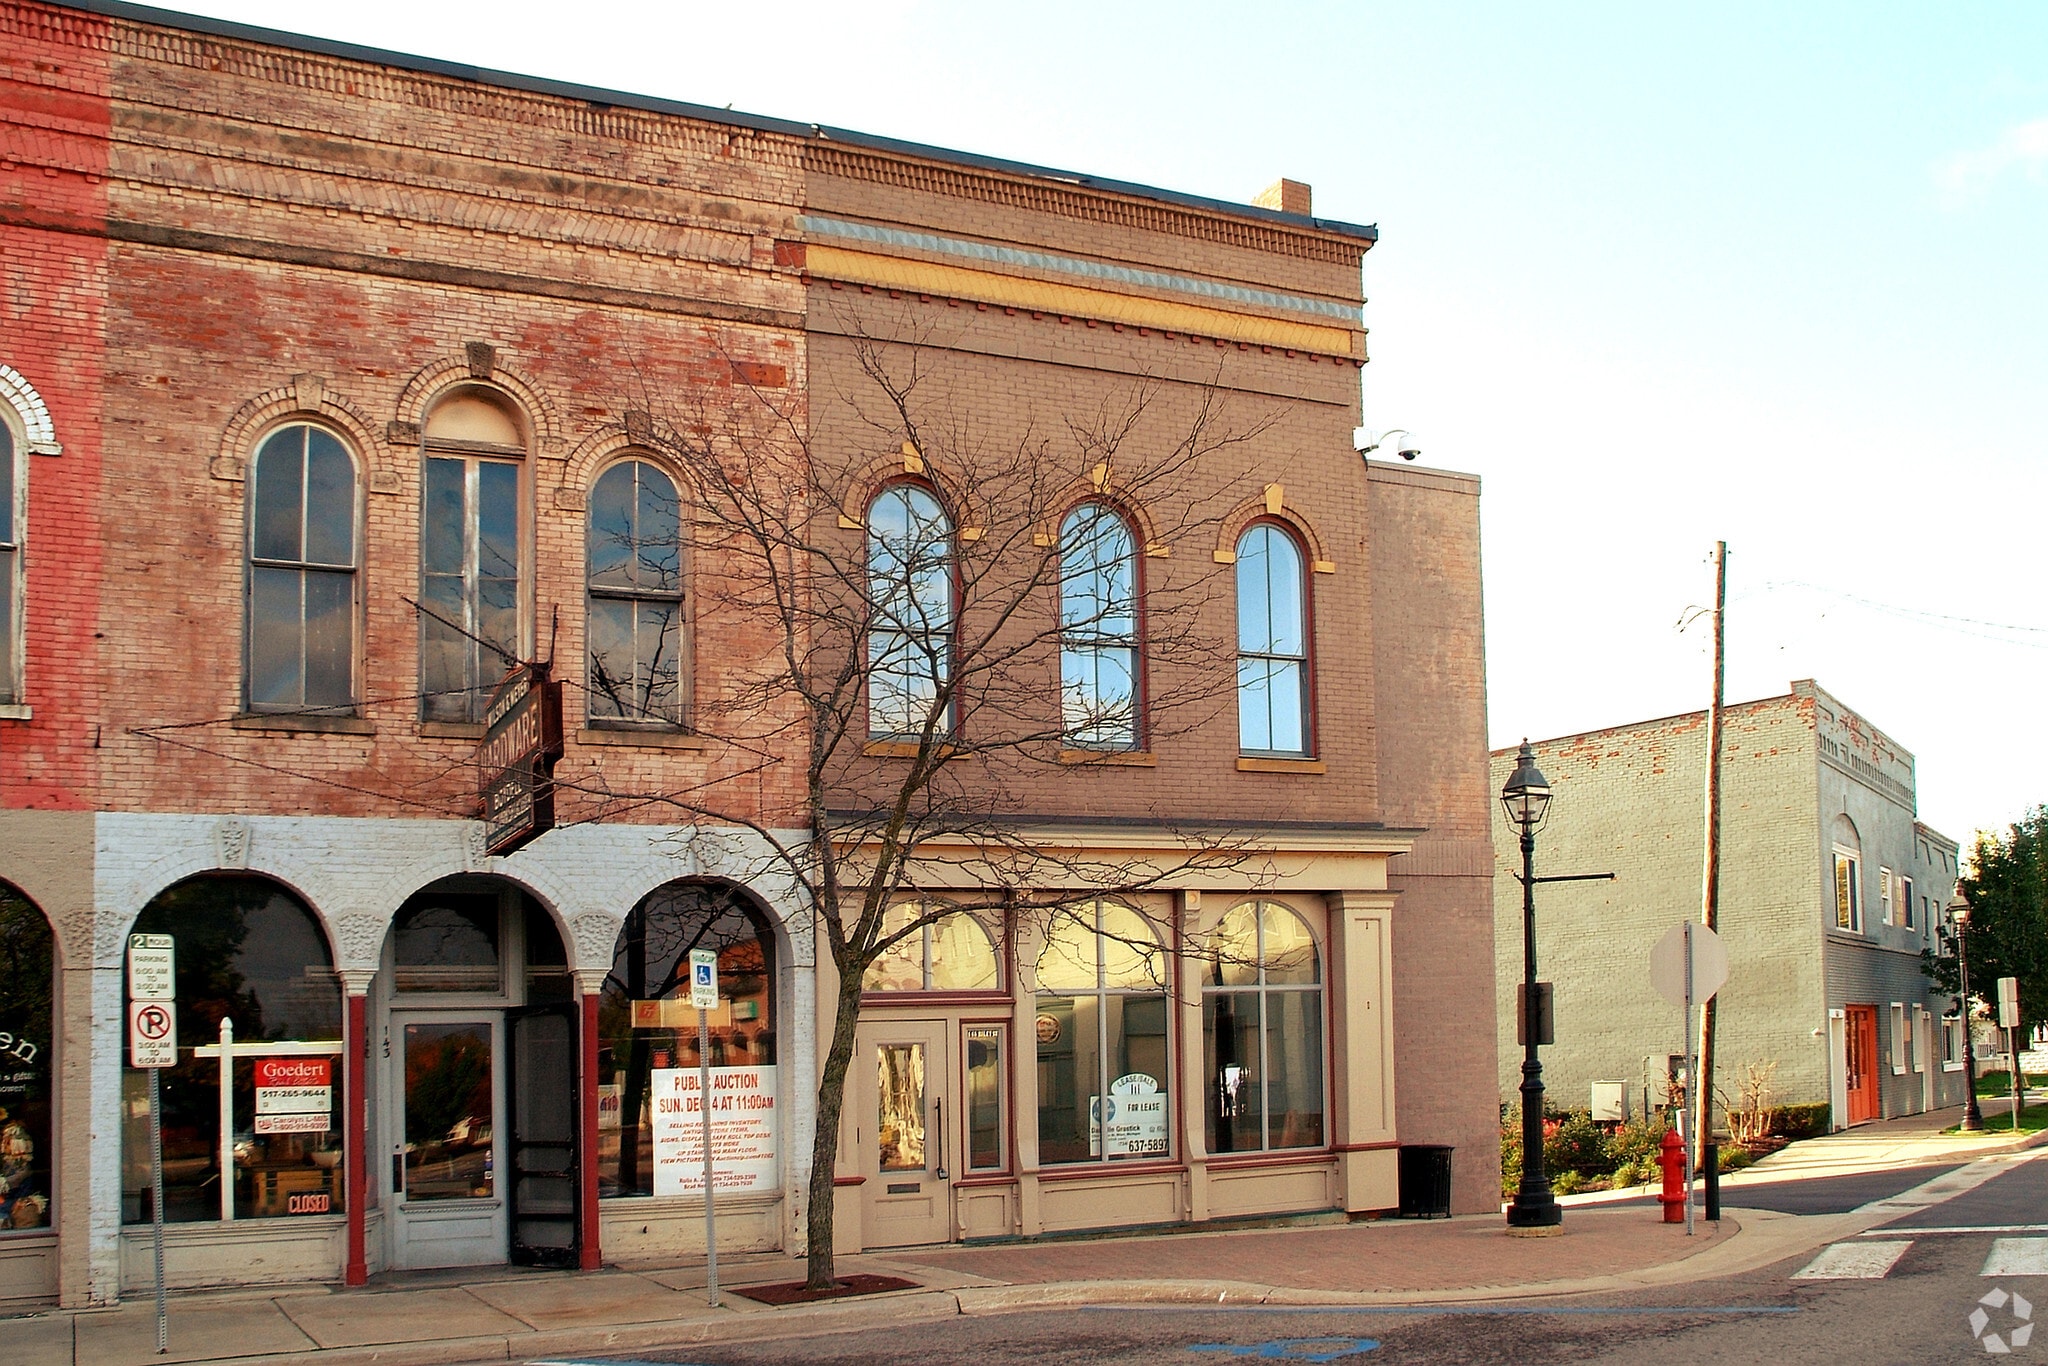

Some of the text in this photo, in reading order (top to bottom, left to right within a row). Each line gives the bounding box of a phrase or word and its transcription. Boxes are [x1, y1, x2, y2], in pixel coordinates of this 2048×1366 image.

[480, 702, 538, 786] HARDWARE
[134, 936, 144, 948] 2
[263, 1063, 324, 1076] Goedert
[674, 1074, 758, 1090] PUBL AUCTION
[1117, 1074, 1154, 1087] LEASE/SALE
[660, 1098, 684, 1112] SUN.
[712, 1096, 718, 1110] 4
[720, 1096, 733, 1110] AT
[737, 1094, 774, 1110] 11:00AM
[1128, 1102, 1160, 1112] FOR LEASE
[289, 1194, 330, 1213] CLOSED
